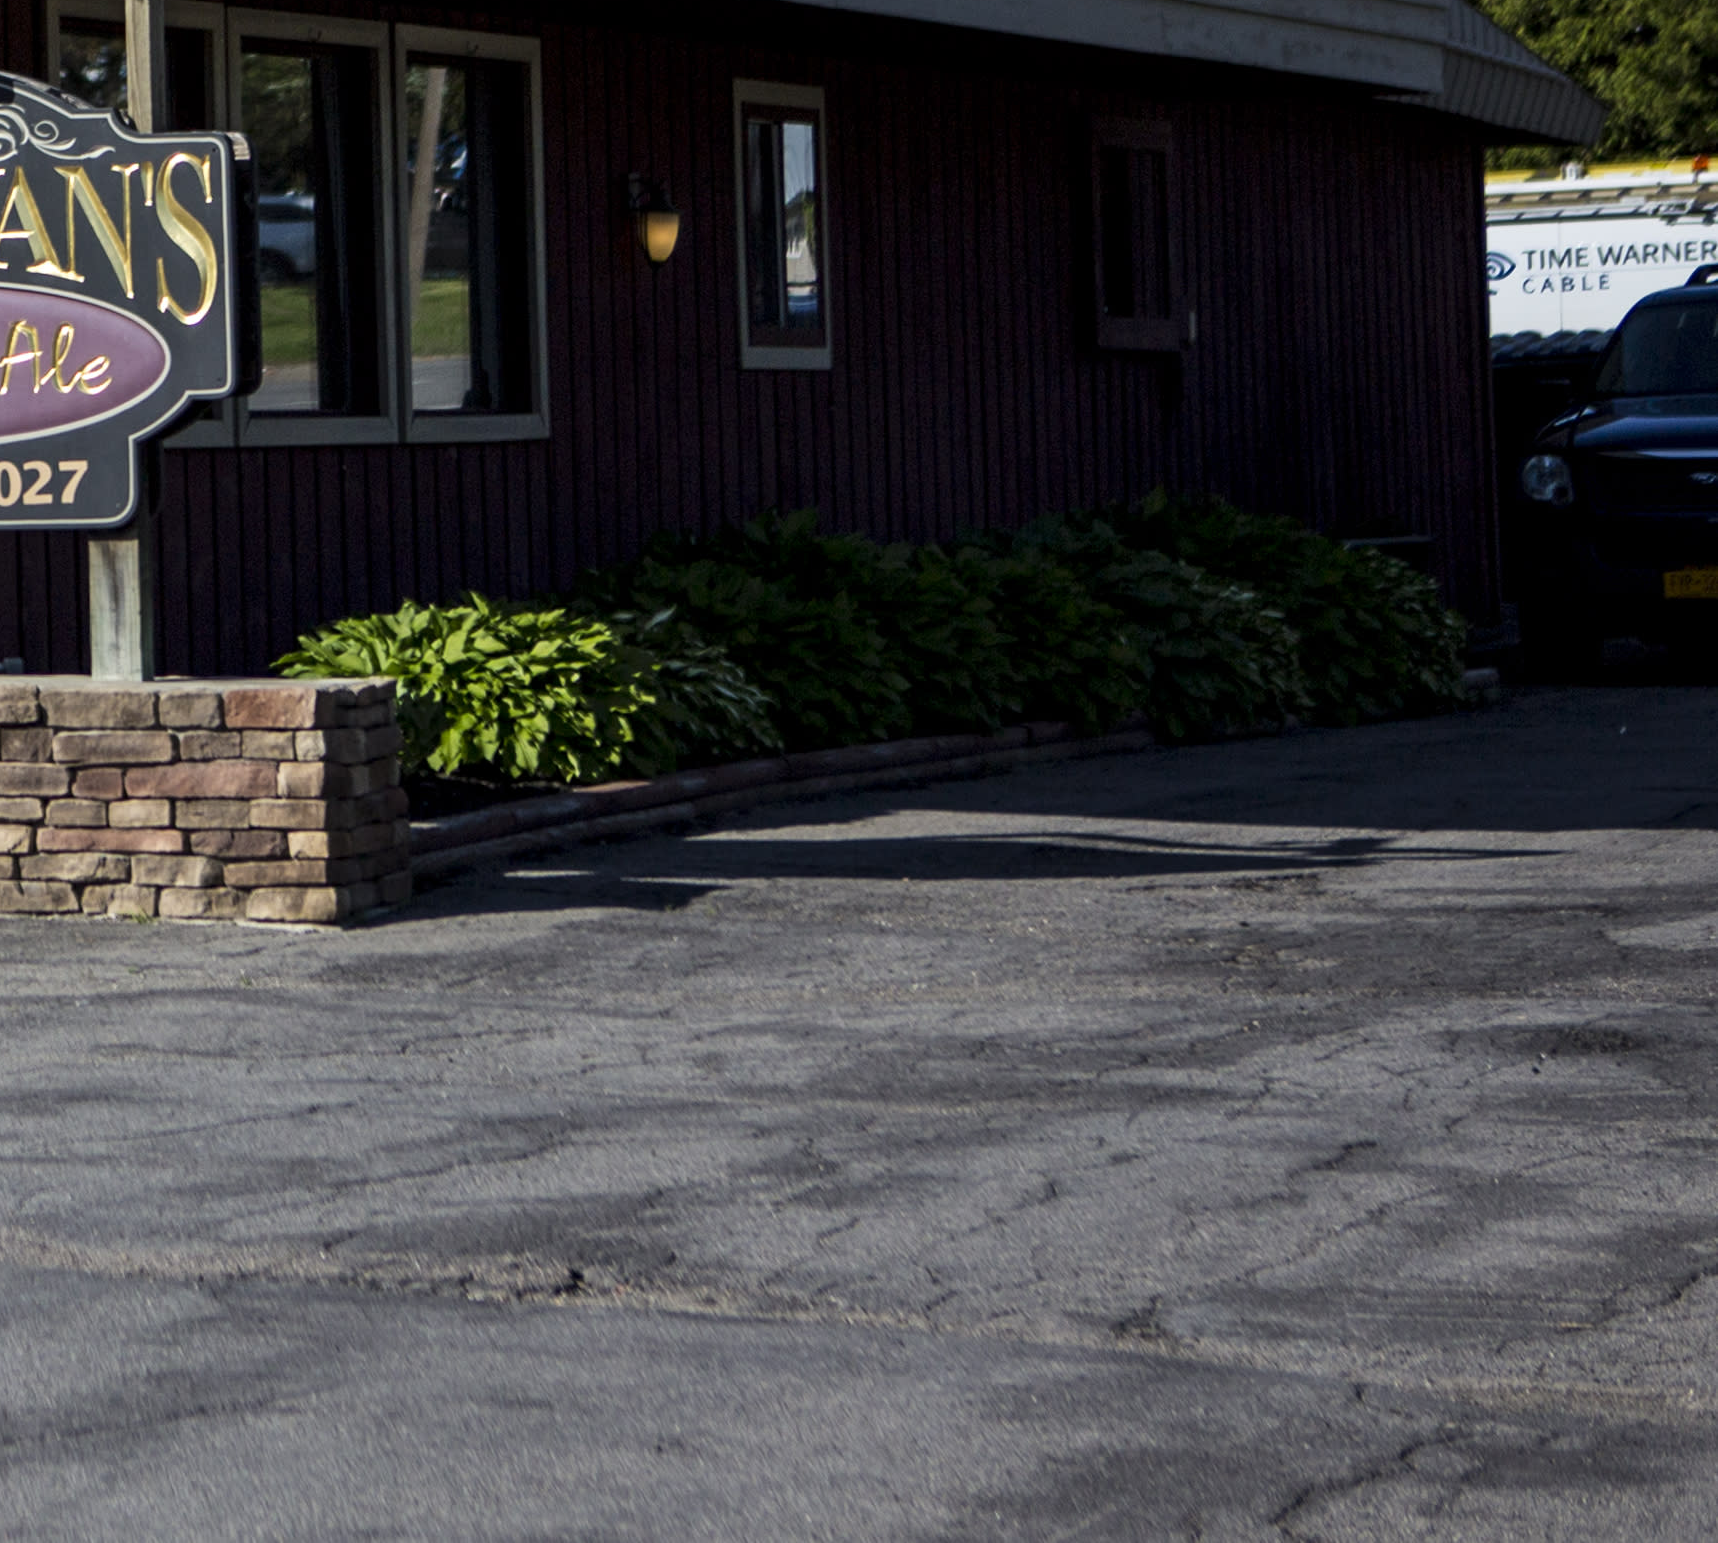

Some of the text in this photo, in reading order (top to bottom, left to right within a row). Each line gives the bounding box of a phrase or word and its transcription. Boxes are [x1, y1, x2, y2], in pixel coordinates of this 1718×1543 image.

[1522, 240, 1718, 271] TIME WARNER
[1522, 274, 1611, 294] CABLE
